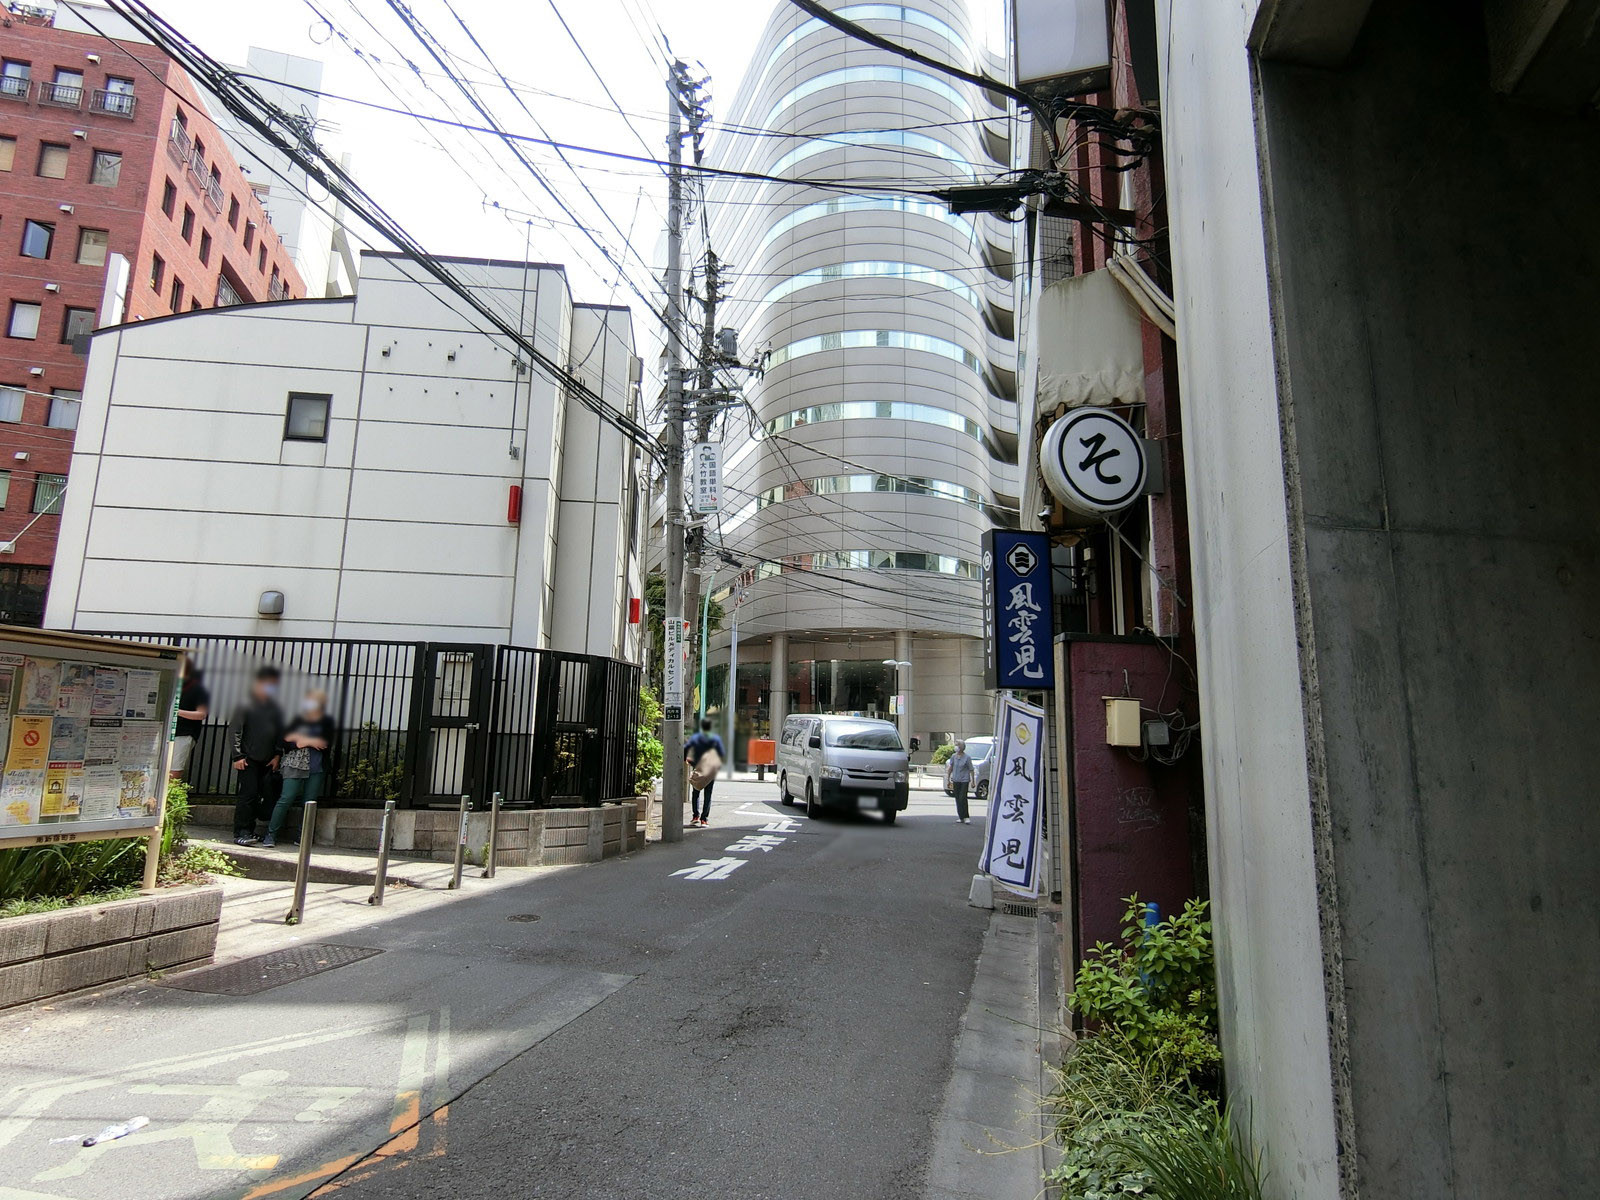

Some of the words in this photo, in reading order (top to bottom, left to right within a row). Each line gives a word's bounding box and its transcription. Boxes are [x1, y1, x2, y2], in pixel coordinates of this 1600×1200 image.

[699, 461, 708, 494] 大竹教室
[708, 461, 717, 494] 国語単科
[1078, 432, 1121, 485] そ
[1005, 582, 1044, 679] 風雲児
[992, 756, 1033, 870] 風雲児
[668, 820, 802, 881] 止まれ
